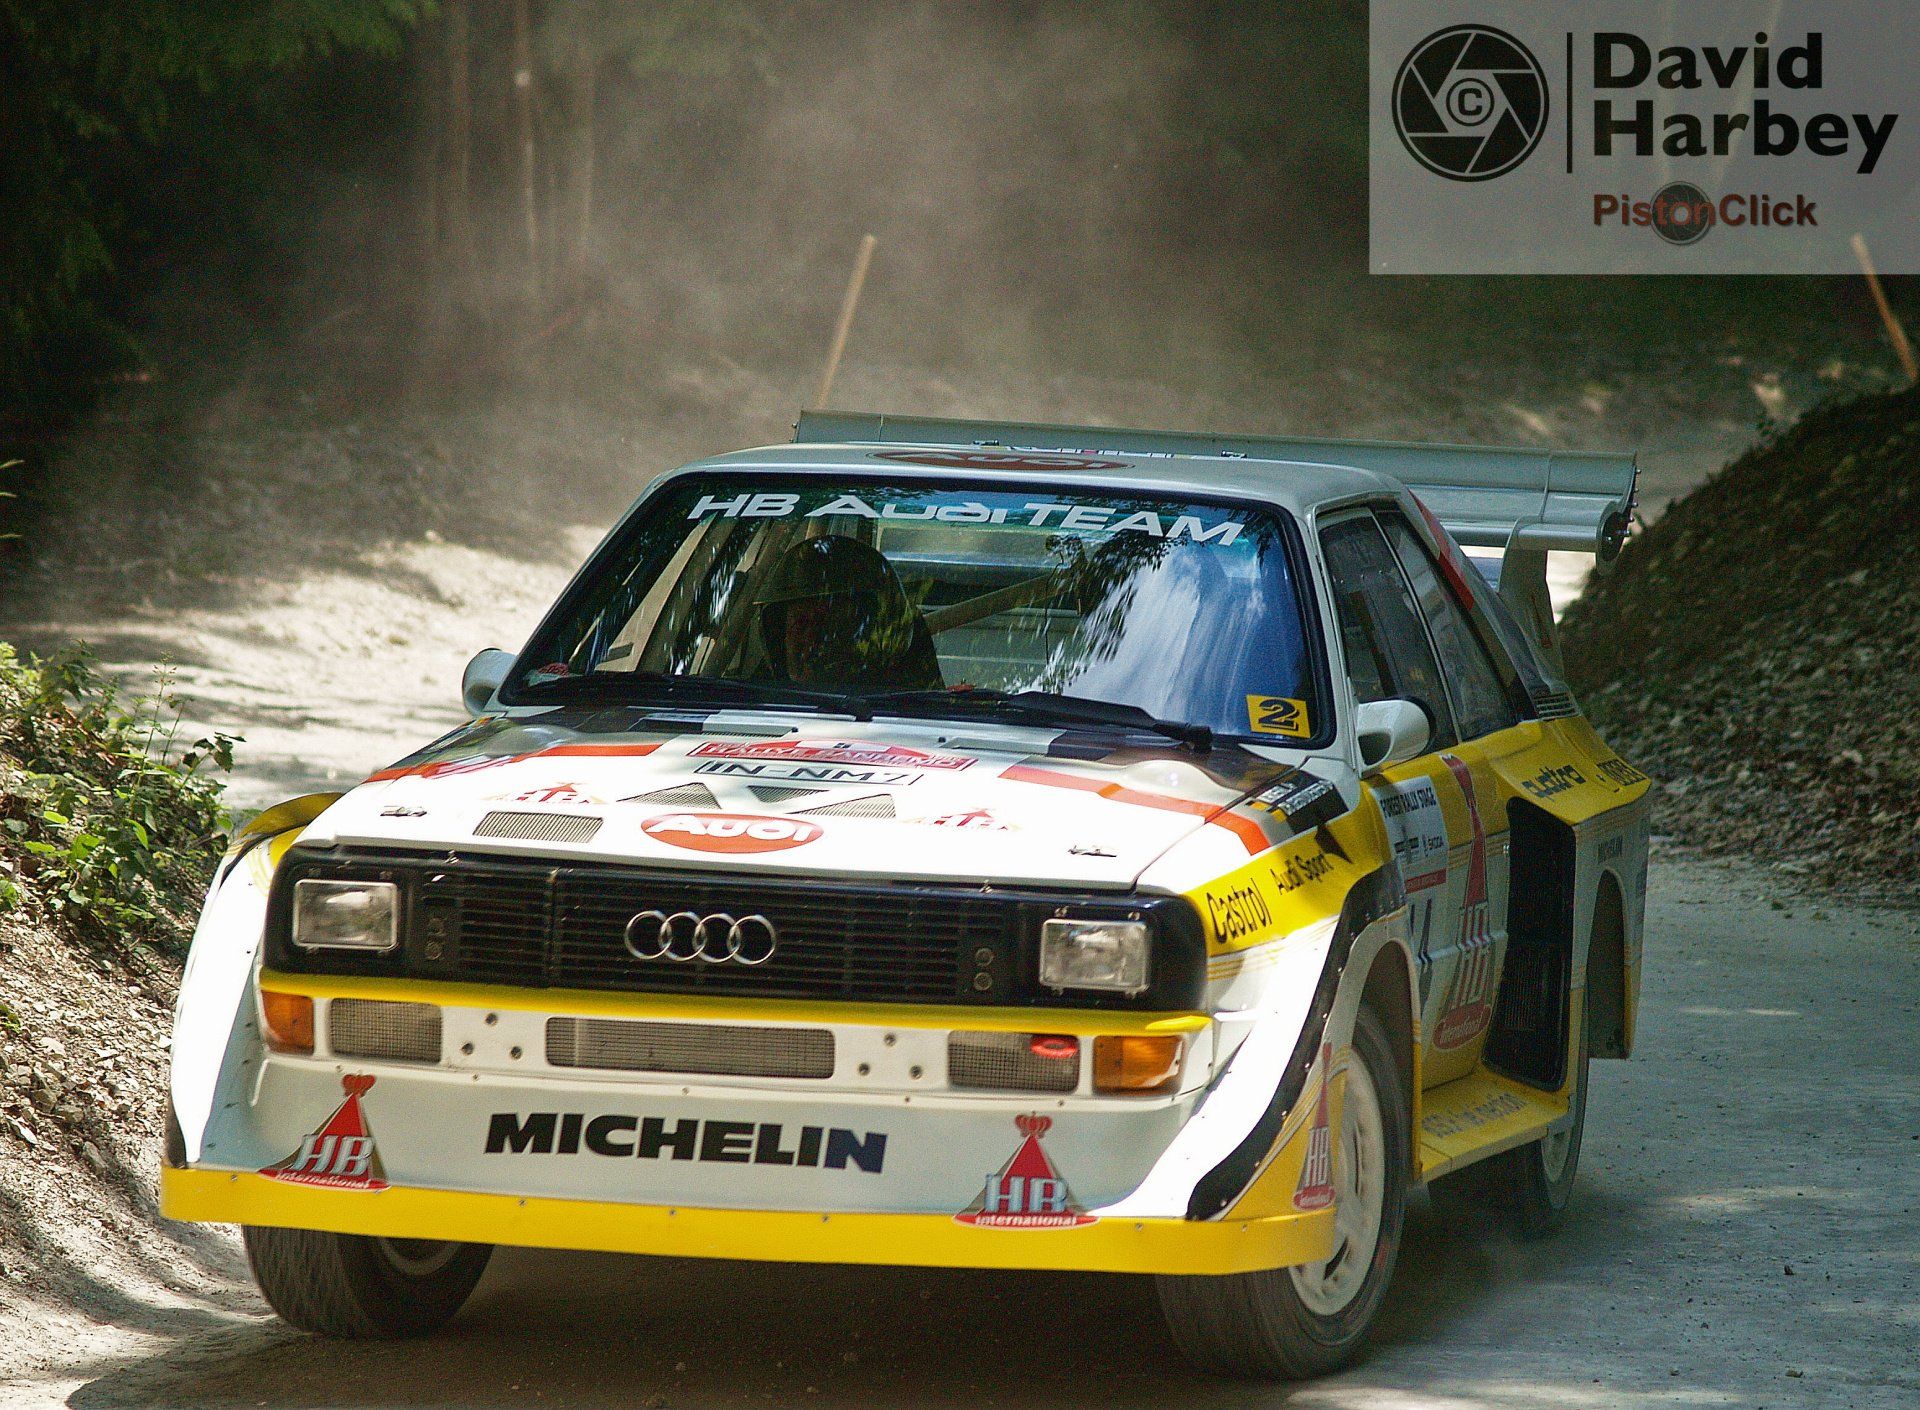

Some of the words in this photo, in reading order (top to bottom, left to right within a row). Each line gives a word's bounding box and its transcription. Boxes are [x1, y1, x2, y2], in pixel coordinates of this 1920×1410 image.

[686, 493, 801, 520] HB
[1023, 502, 1246, 547] TEAM
[1257, 698, 1301, 730] 2
[706, 762, 910, 782] IN-NM7
[1206, 878, 1273, 943] Castrol
[291, 1134, 375, 1177] HB
[485, 1112, 887, 1175] MICHELIN
